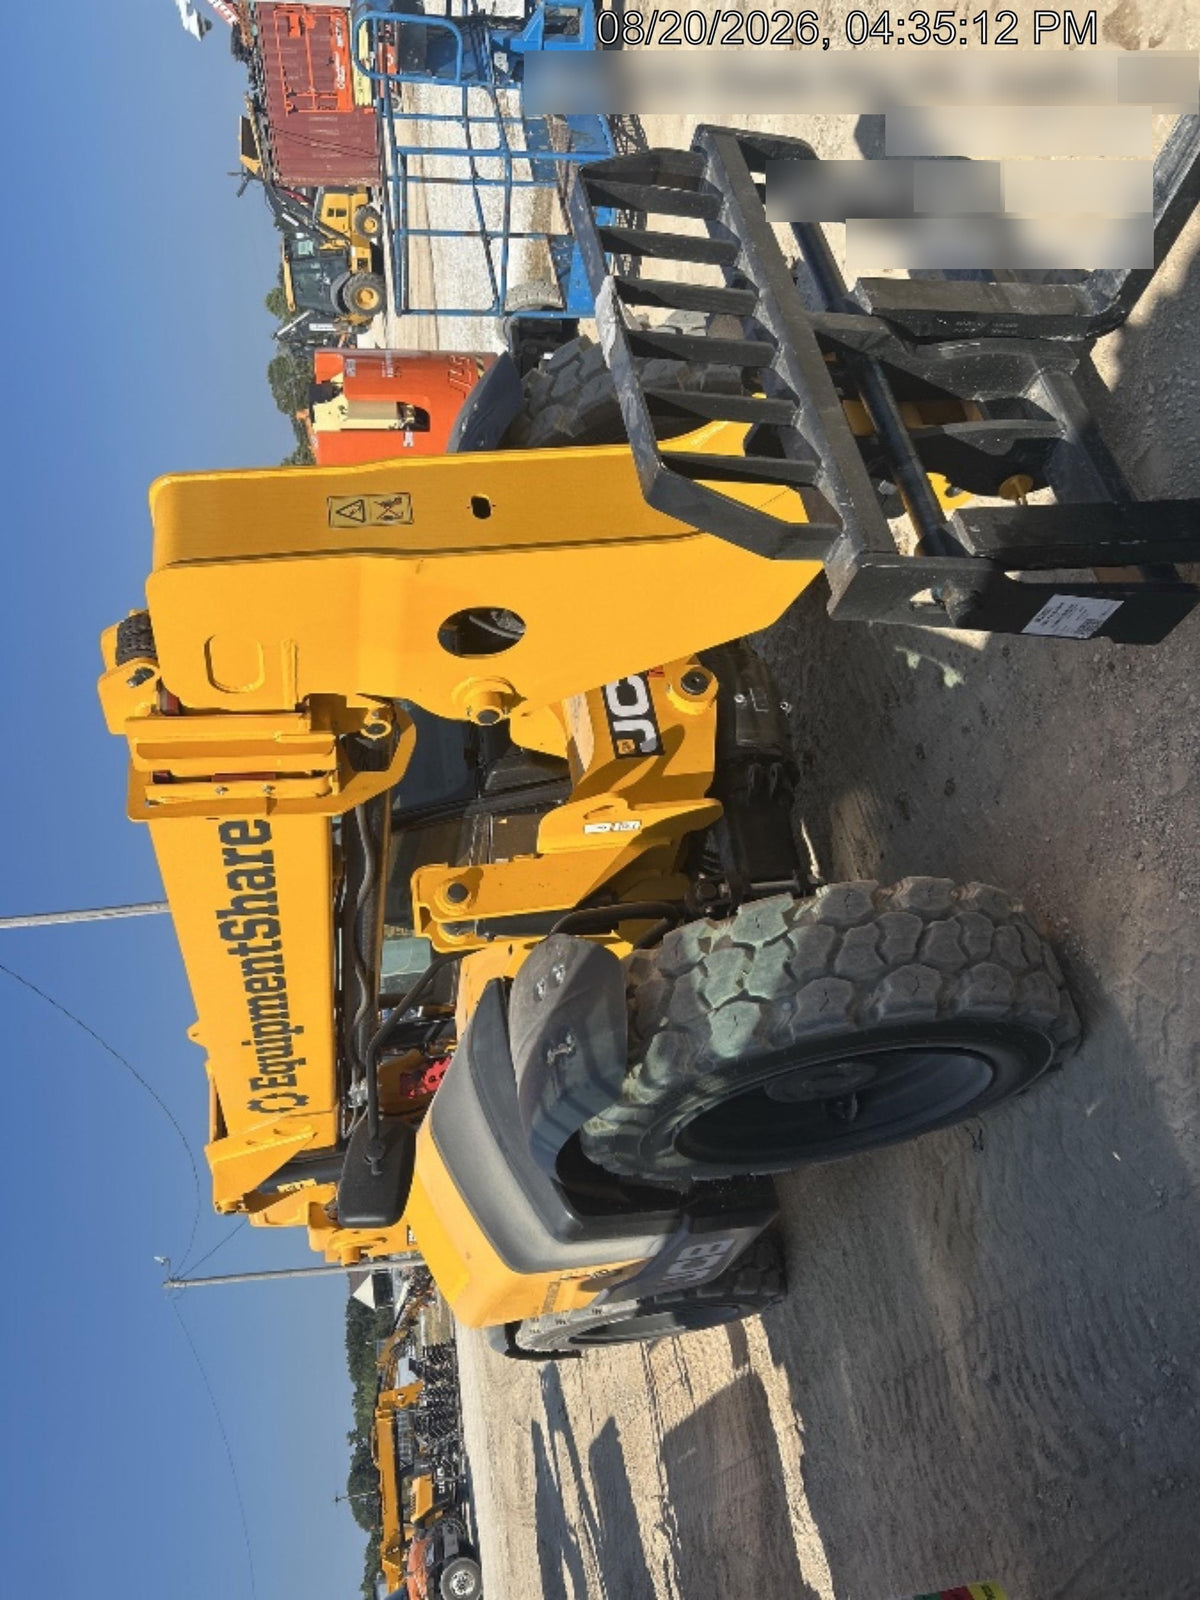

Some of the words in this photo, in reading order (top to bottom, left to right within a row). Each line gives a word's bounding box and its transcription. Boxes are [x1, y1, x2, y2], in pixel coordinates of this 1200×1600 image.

[605, 675, 658, 753] JC
[215, 819, 306, 1091] EquipmentShare
[662, 1239, 735, 1282] JCB
